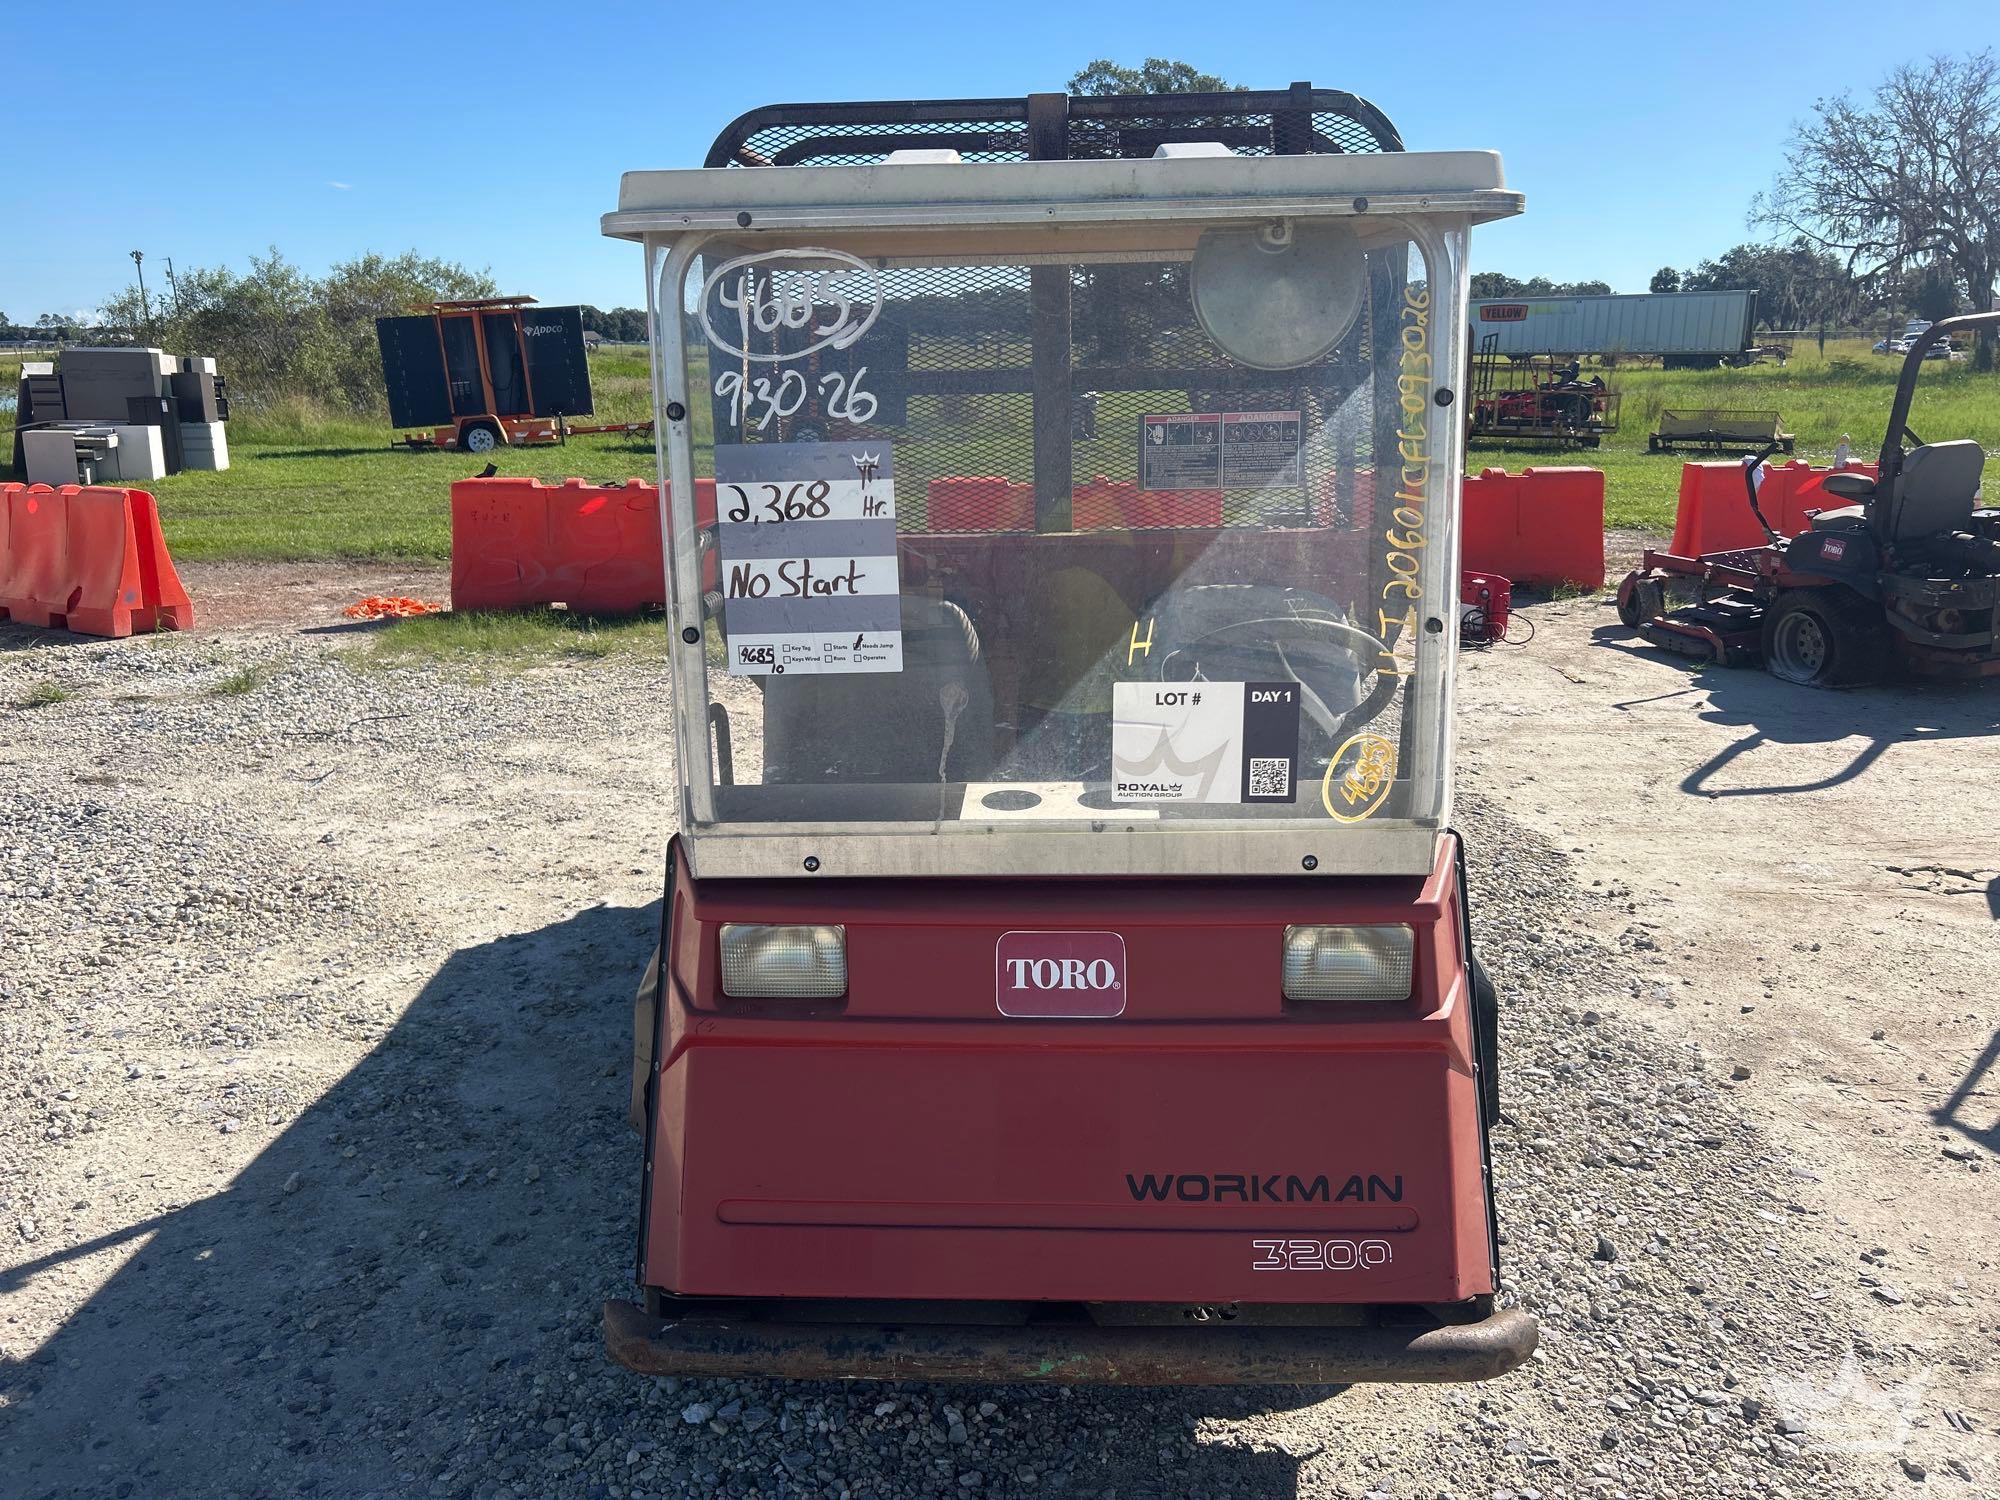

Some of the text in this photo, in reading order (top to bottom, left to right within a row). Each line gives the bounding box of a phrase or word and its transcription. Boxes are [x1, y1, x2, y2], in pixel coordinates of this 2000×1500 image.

[719, 272, 857, 349] 4685
[1487, 307, 1522, 318] YELLOW
[532, 325, 563, 336] ADDCO
[728, 480, 831, 525] 2,368
[1823, 543, 1843, 555] TORO
[729, 559, 866, 599] No Start
[1128, 617, 1154, 666] H
[771, 664, 785, 674] 10
[1155, 692, 1202, 706] LOT #
[1251, 690, 1291, 703] DAY 1
[1117, 783, 1168, 792] ROYAL
[1125, 1174, 1403, 1203] WORKMAN
[1252, 1239, 1393, 1271] 3200
